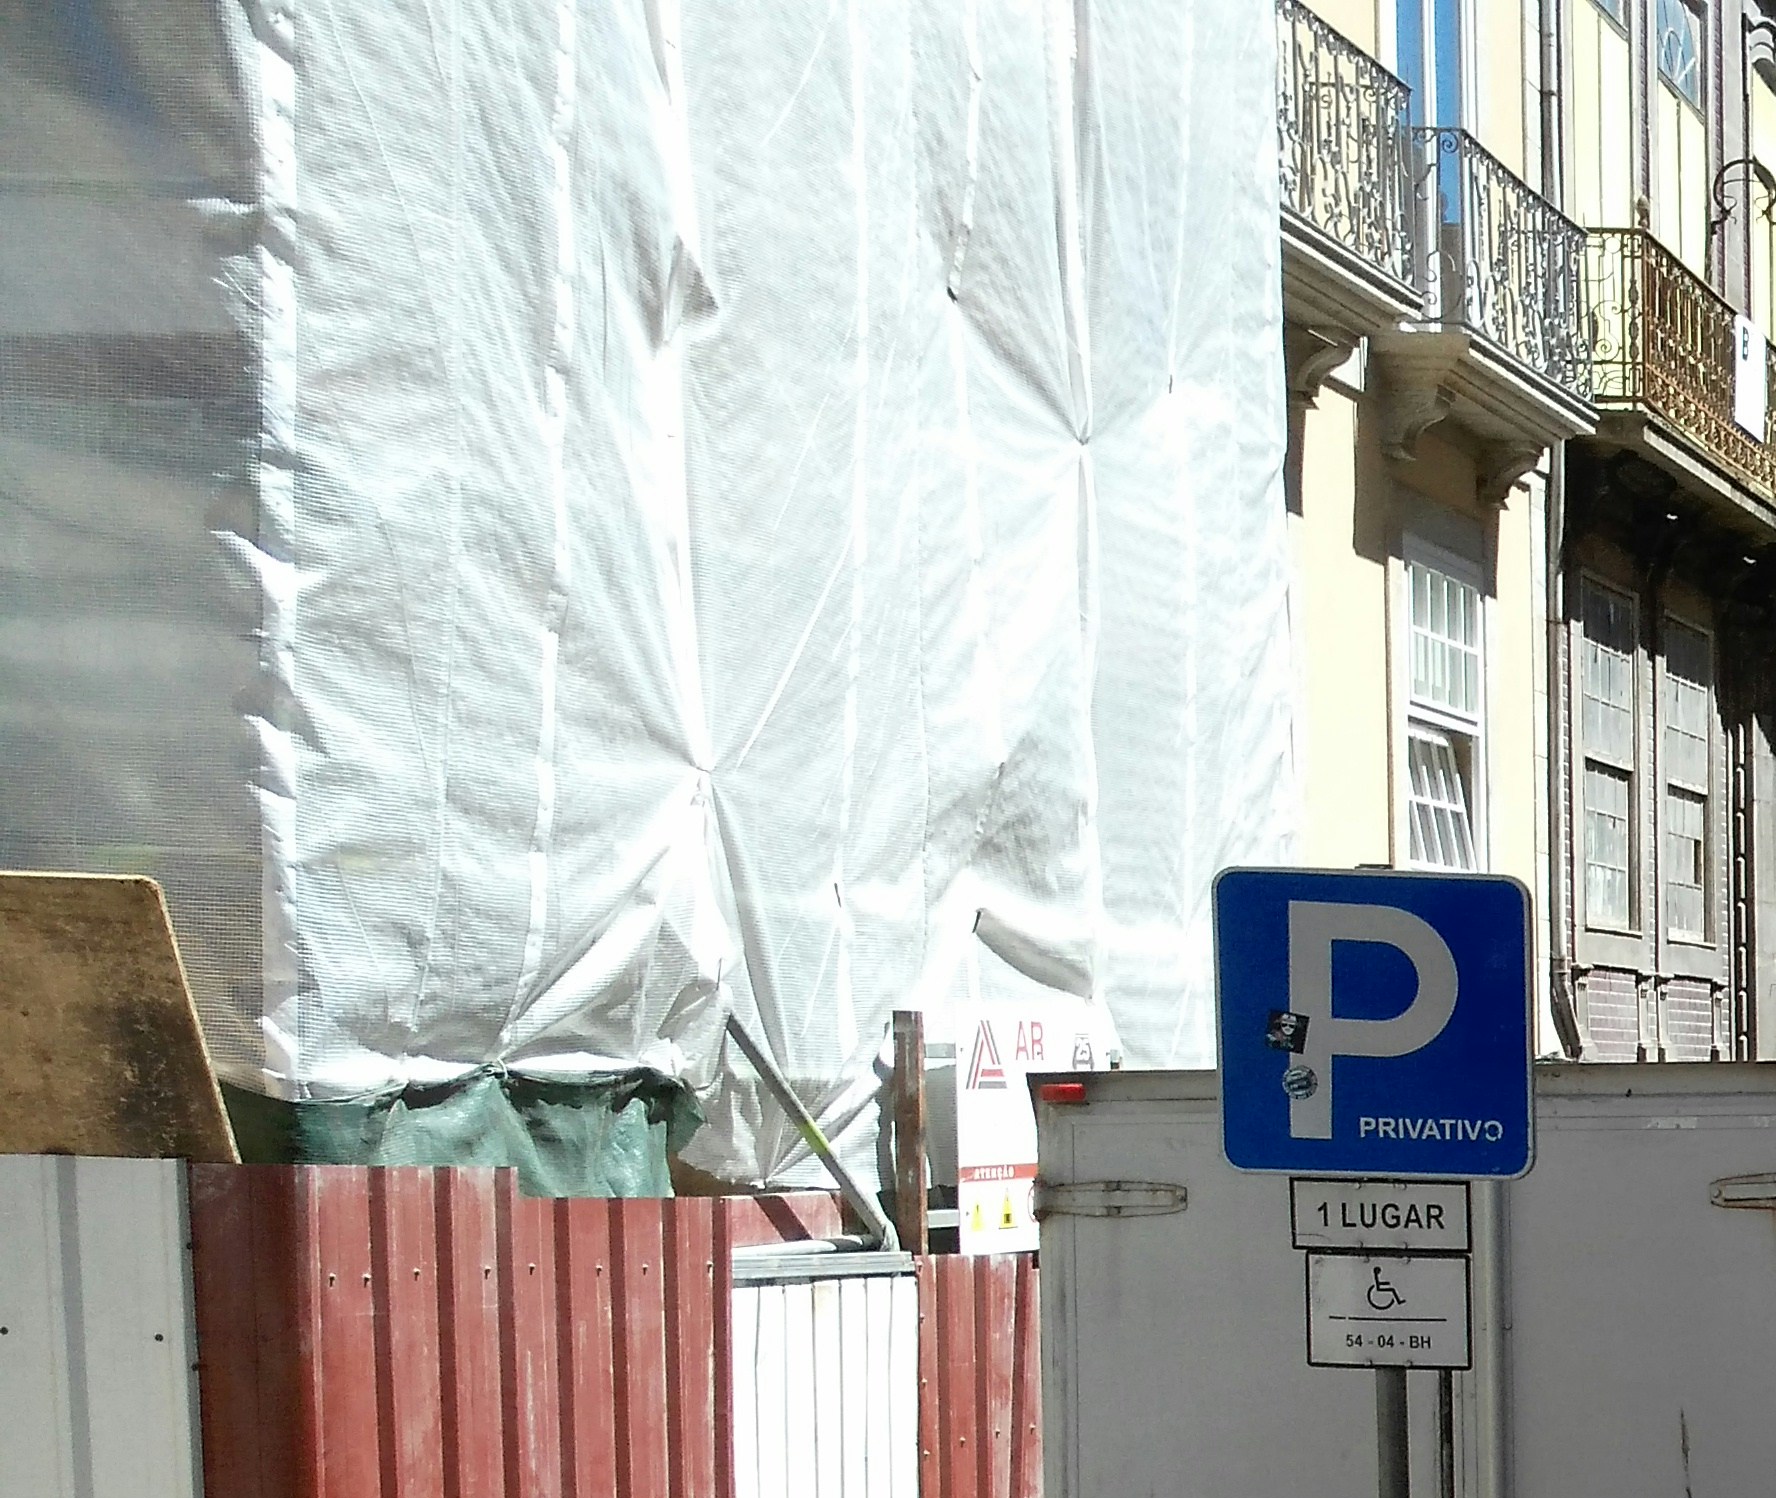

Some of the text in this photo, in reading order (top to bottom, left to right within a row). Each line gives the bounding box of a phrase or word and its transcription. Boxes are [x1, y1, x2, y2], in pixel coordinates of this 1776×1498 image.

[1358, 1117, 1503, 1142] PRIVATIVO
[1317, 1202, 1445, 1230] 1 LUGAR
